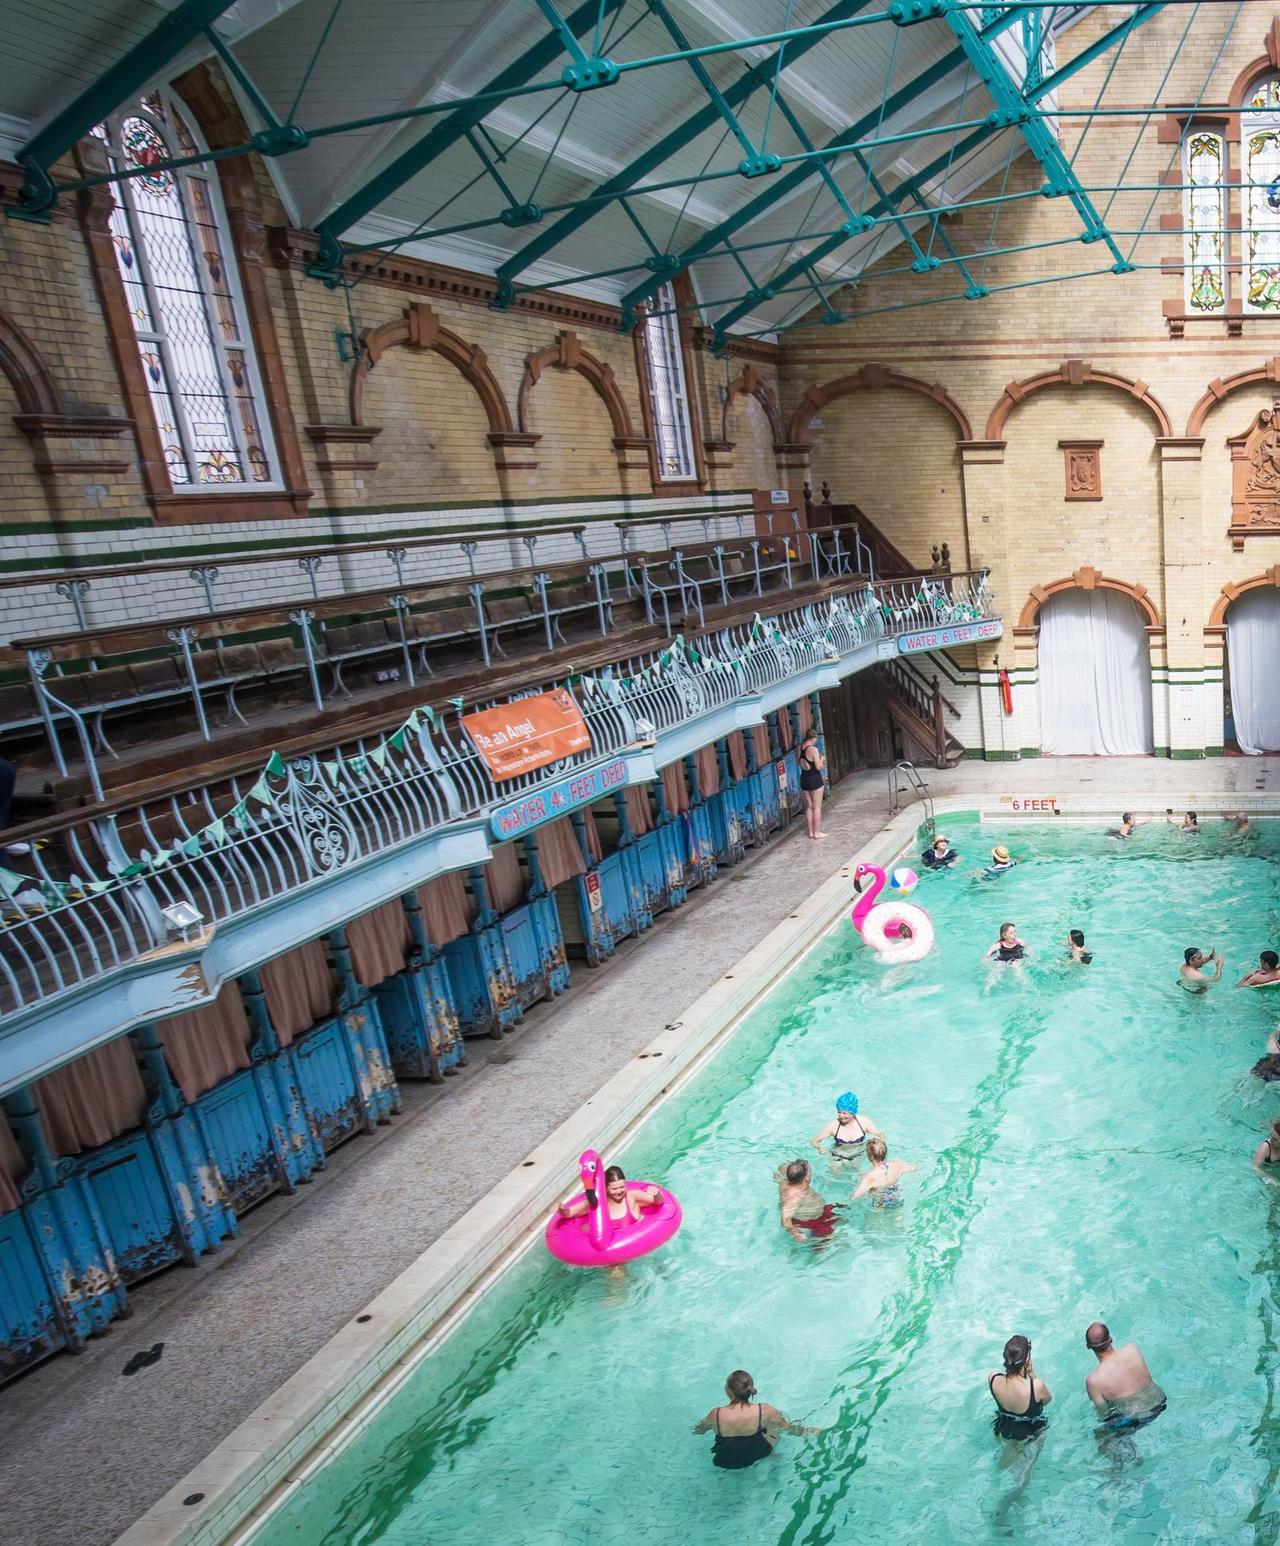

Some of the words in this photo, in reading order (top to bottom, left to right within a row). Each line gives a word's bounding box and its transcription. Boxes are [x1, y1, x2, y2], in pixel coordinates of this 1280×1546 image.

[906, 633, 938, 649] WATER
[942, 632, 949, 643] 6
[953, 628, 973, 640] FEET
[977, 623, 998, 637] DEEP
[493, 733, 505, 744] an
[506, 719, 536, 738] Angel
[498, 799, 545, 832] WATER
[570, 774, 595, 802] FEET
[601, 762, 624, 788] DEEP
[1012, 800, 1020, 810] 6
[1023, 799, 1057, 810] FEET
